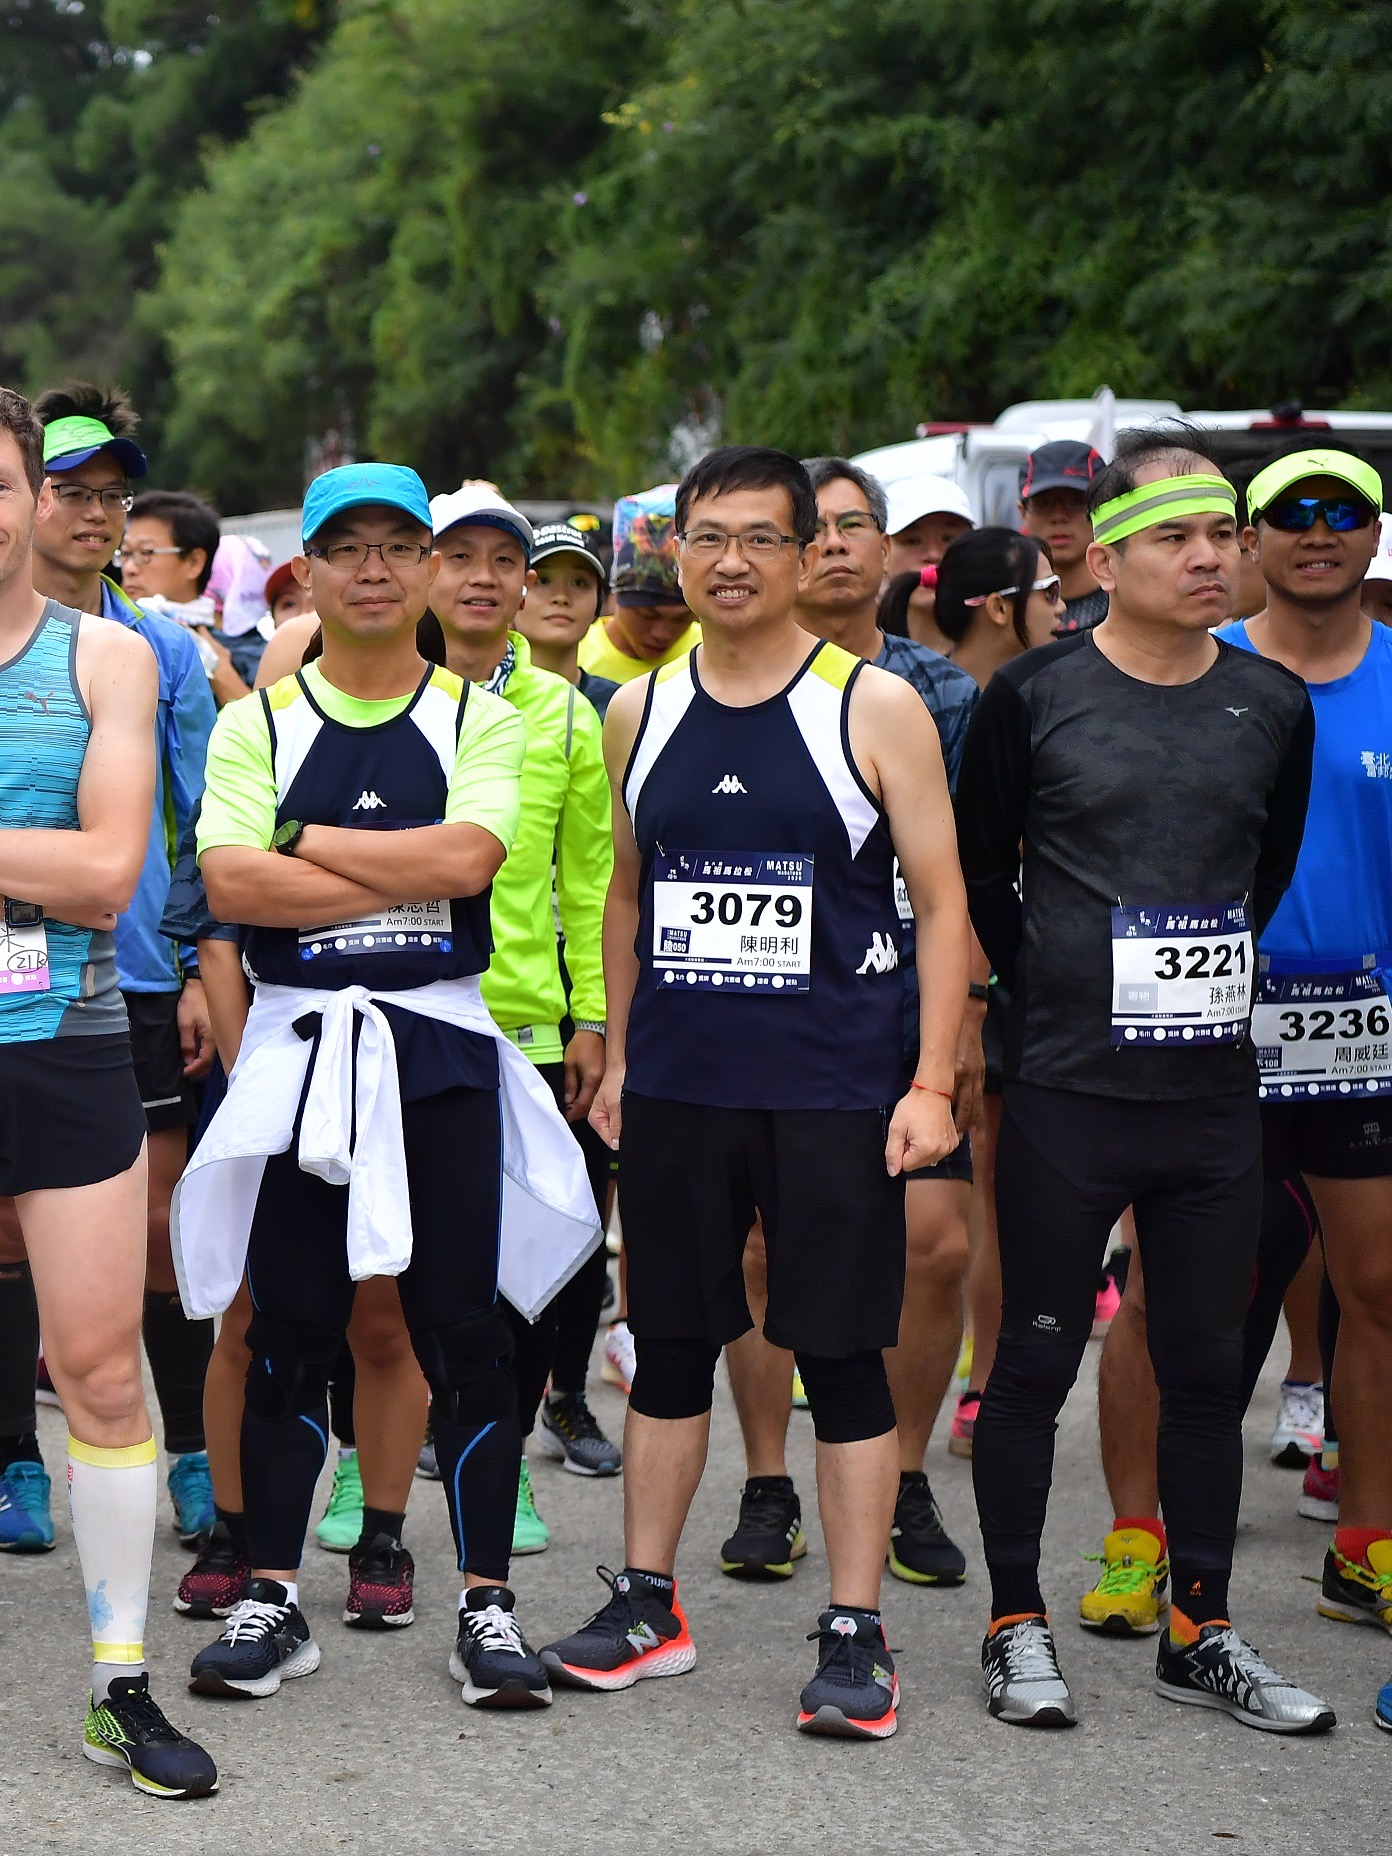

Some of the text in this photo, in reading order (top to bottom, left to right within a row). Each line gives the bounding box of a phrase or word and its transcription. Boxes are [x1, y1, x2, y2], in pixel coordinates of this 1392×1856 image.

[702, 865, 753, 877] 馬祖馬拉松
[766, 860, 803, 871] MATSU
[690, 891, 802, 928] 3079
[387, 917, 422, 926] Am7:00
[669, 929, 688, 938] MATSU
[664, 939, 687, 953] 陸050
[740, 935, 799, 955] 陳明利
[736, 956, 801, 968] Am7:00 START
[1155, 941, 1246, 980] 3221
[1209, 982, 1246, 1005] 孫燕林
[1207, 1007, 1235, 1018] Am7:00
[1279, 1005, 1390, 1042] 3236
[1335, 1042, 1388, 1063] 周威廷
[1331, 1065, 1367, 1075] Am7:00
